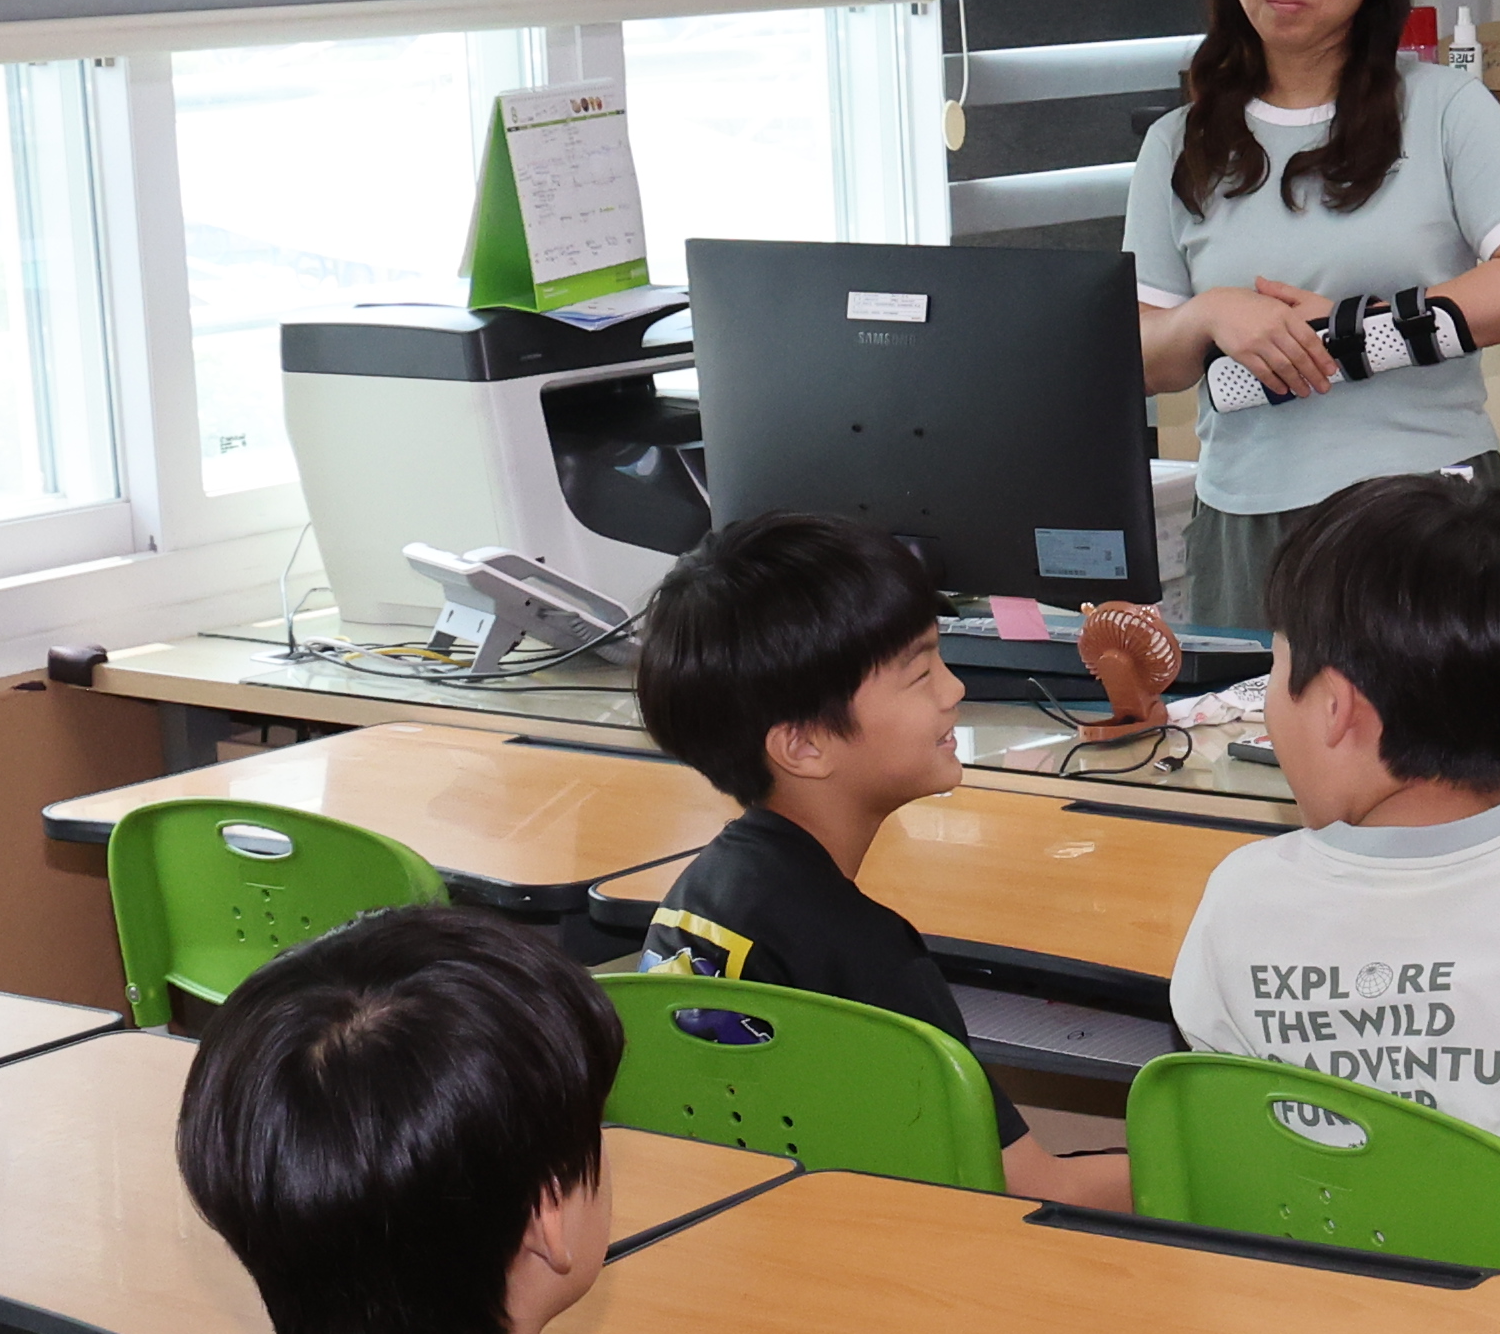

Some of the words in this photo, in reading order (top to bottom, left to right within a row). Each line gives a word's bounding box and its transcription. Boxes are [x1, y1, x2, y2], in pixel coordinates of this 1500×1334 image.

[1250, 962, 1456, 1000] EXPLORE
[1254, 1009, 1337, 1044] THE
[1338, 1002, 1456, 1037] WILD
